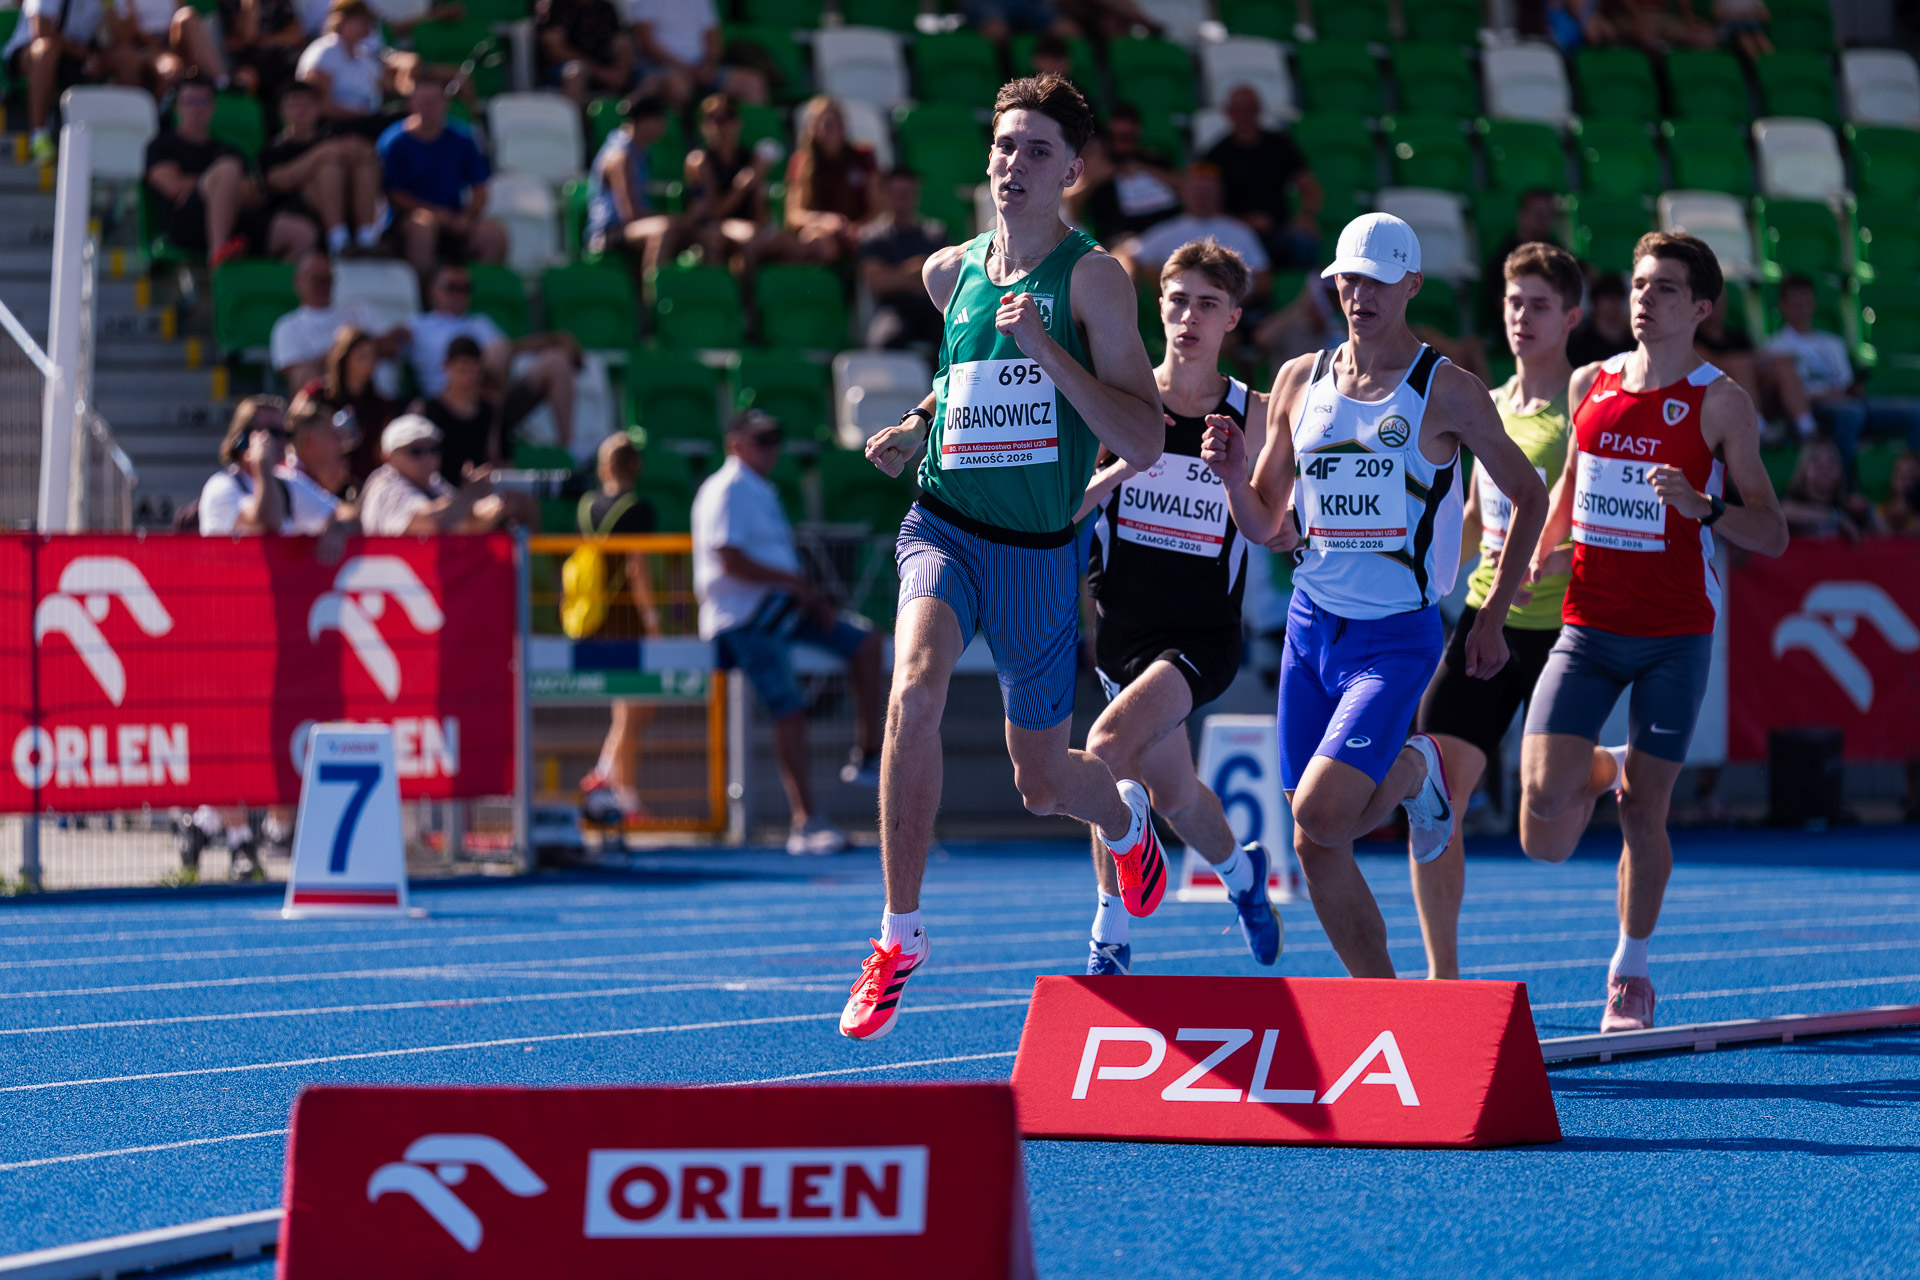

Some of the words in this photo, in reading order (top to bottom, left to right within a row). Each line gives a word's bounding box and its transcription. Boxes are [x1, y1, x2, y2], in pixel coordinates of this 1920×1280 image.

[999, 364, 1042, 386] 695
[947, 402, 1052, 430] URBANOWICZ
[1383, 420, 1406, 434] RKS
[972, 444, 1011, 452] Mistrzostwa
[1013, 440, 1032, 449] Polski
[1034, 440, 1047, 448] U20
[1600, 432, 1662, 456] PIAST
[960, 452, 1004, 464] ZAMOŚĆ
[1006, 452, 1032, 462] 2026
[1306, 457, 1342, 480] 4F
[1355, 458, 1394, 478] 209
[1622, 465, 1651, 486] 51
[1124, 487, 1223, 522] SUWALSKI
[1320, 494, 1381, 516] KRUK
[1577, 491, 1660, 521] OSTROWSKI
[1136, 533, 1176, 548] ZAMOŚĆ
[1178, 540, 1202, 552] 2026
[1324, 538, 1358, 548] ZAMOŚĆ
[1360, 540, 1384, 548] 2026
[12, 723, 190, 788] ORLEN
[1214, 755, 1263, 848] 6
[318, 763, 383, 875] 7
[1071, 1026, 1421, 1106] PZLA
[607, 1162, 902, 1223] ORLEN
